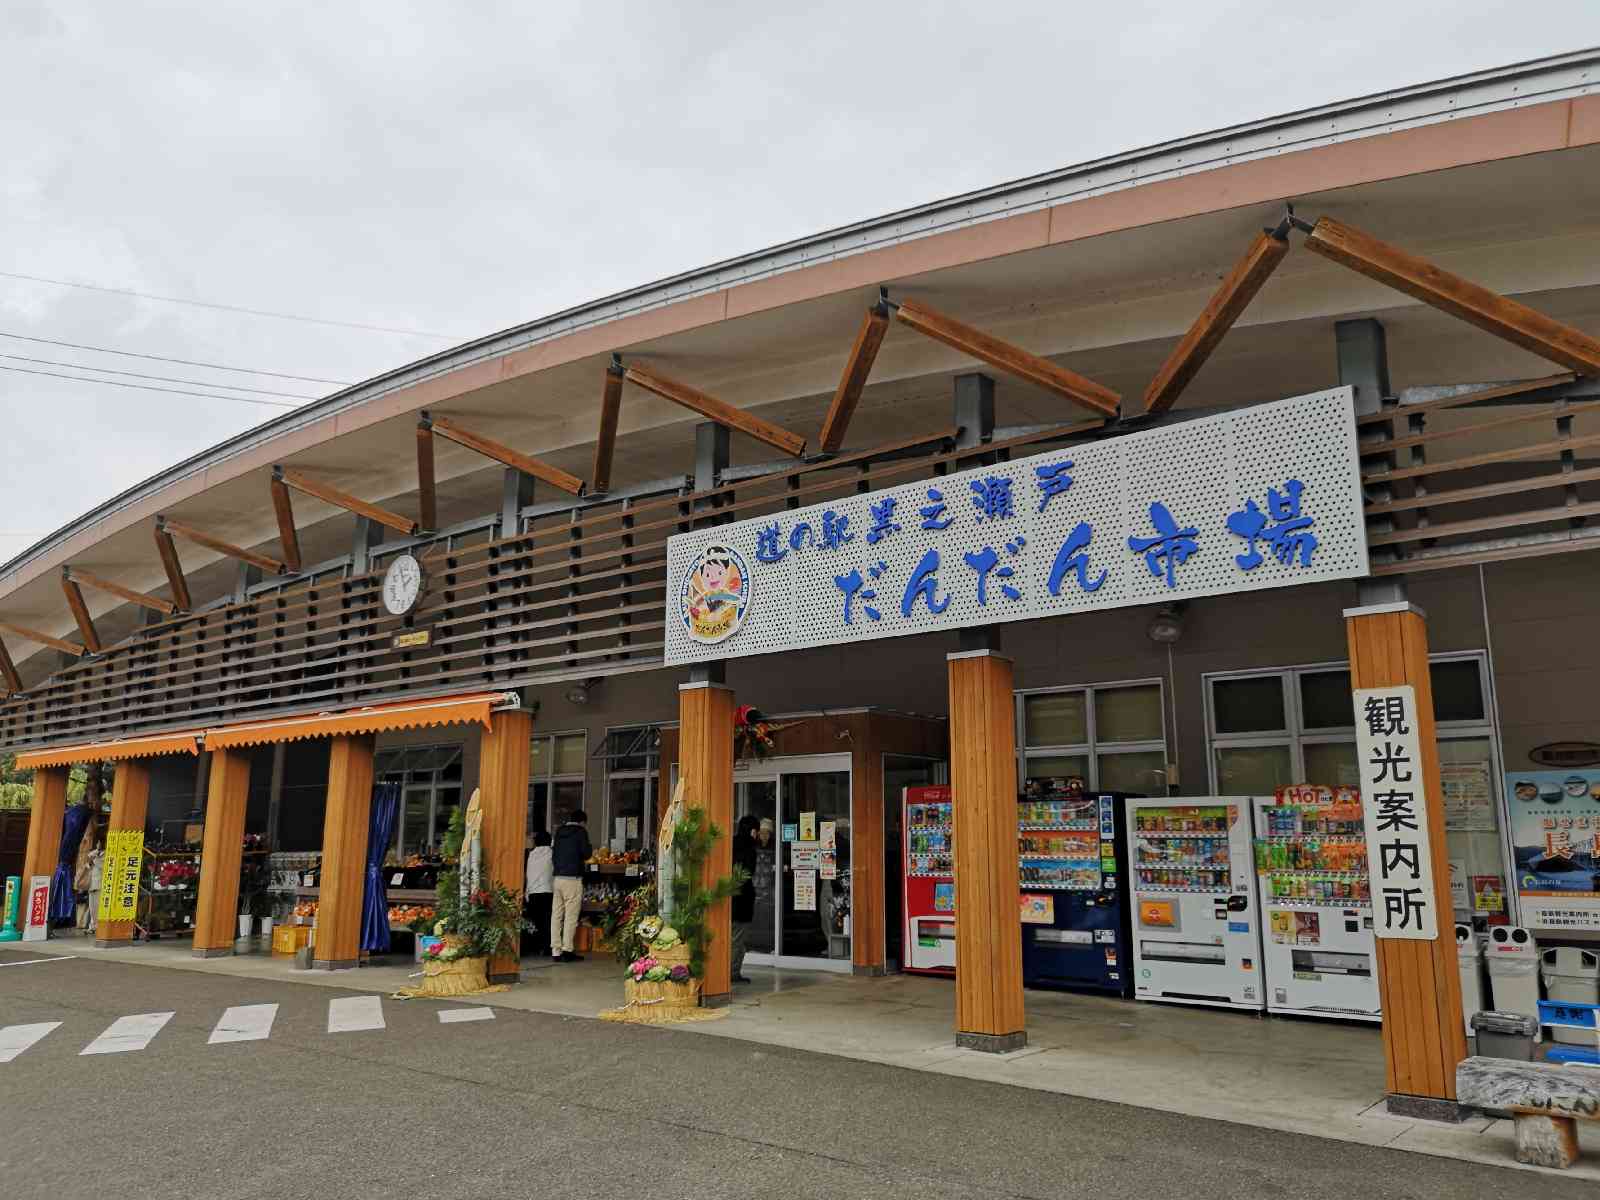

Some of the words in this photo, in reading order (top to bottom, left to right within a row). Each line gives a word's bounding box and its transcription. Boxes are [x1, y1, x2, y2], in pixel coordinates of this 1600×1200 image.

[834, 478, 1318, 624] だんだん市場
[122, 856, 139, 908] 足元注意
[1364, 696, 1426, 930] 観光案内所
